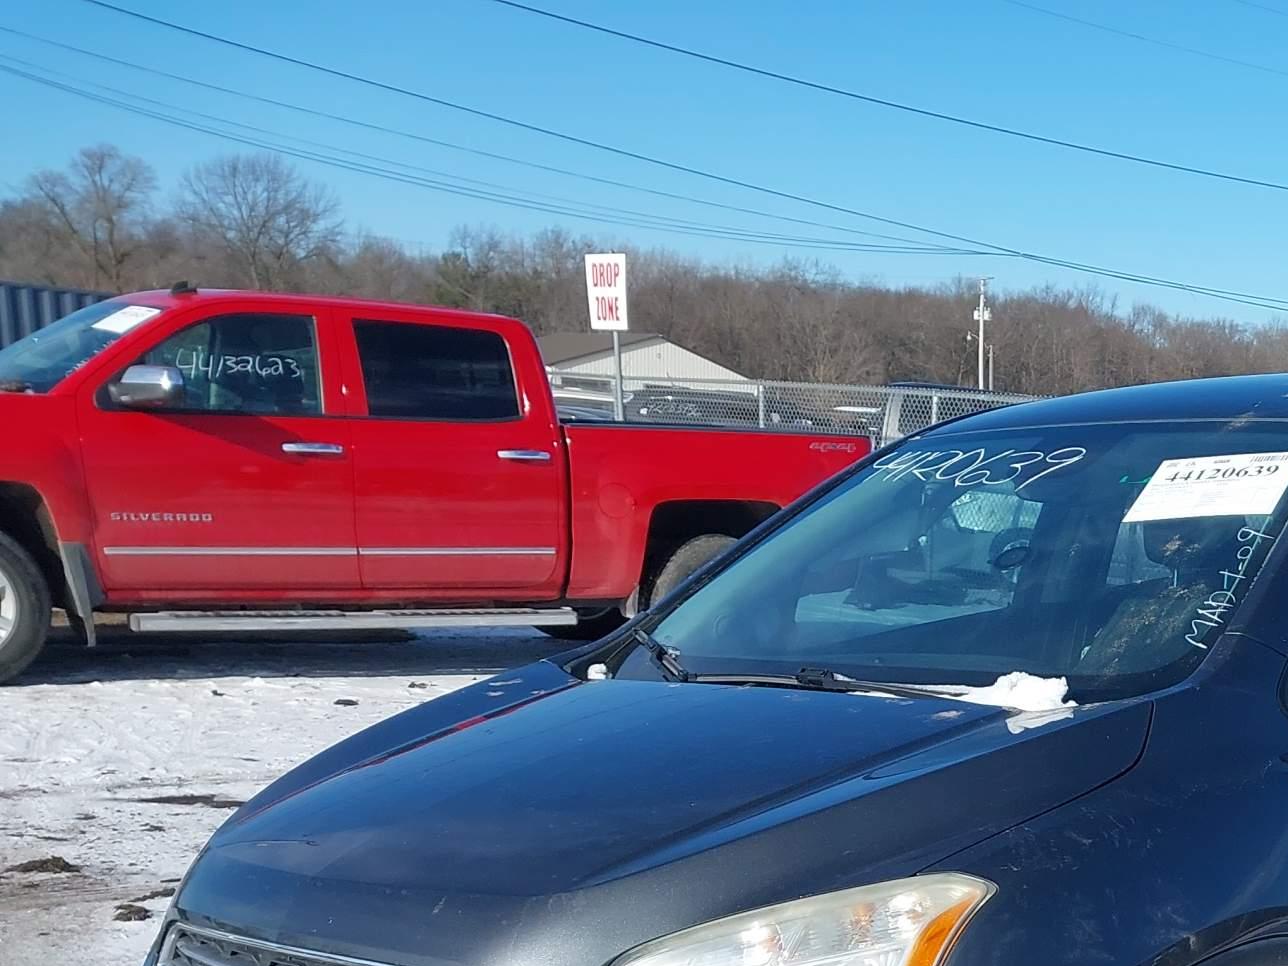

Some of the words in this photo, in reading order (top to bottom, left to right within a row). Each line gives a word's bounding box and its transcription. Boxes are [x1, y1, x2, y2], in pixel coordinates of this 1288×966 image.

[591, 262, 620, 288] DROP
[595, 296, 621, 321] ZONE
[175, 347, 301, 380] 44132623
[1164, 464, 1280, 483] 44120639
[110, 511, 213, 522] SILVERADO
